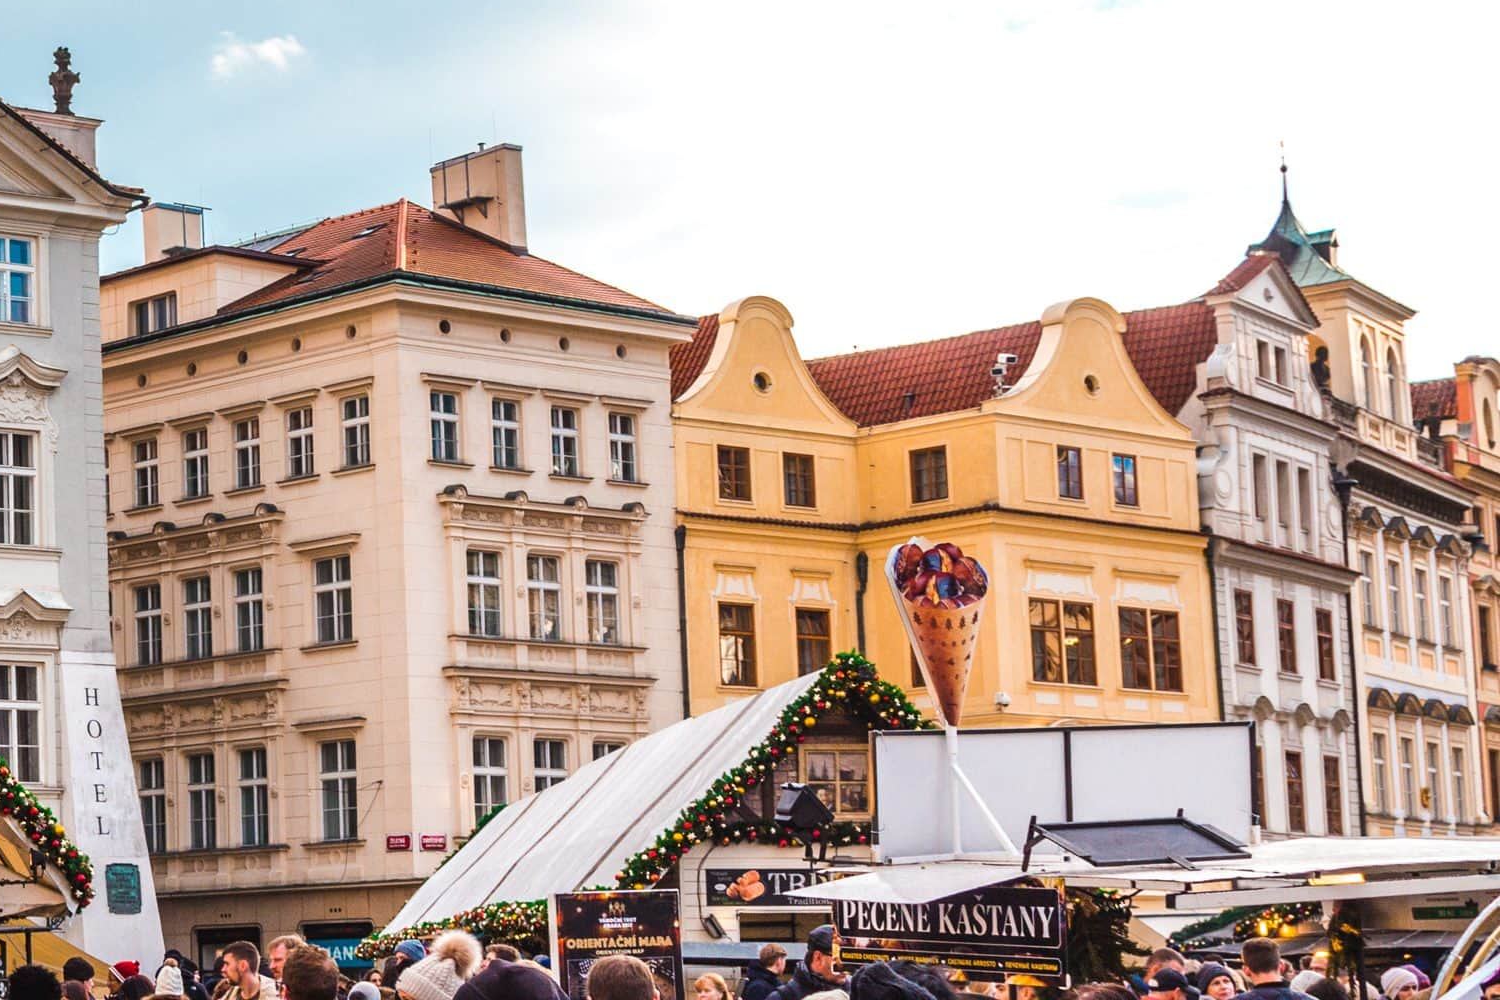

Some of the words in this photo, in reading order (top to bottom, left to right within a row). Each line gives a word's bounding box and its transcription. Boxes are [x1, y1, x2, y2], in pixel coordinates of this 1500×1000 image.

[83, 687, 110, 836] HOTEL
[938, 894, 1055, 939] KAŠTANY
[566, 934, 637, 949] ORIENTAČNÍ
[638, 935, 674, 947] MAPA
